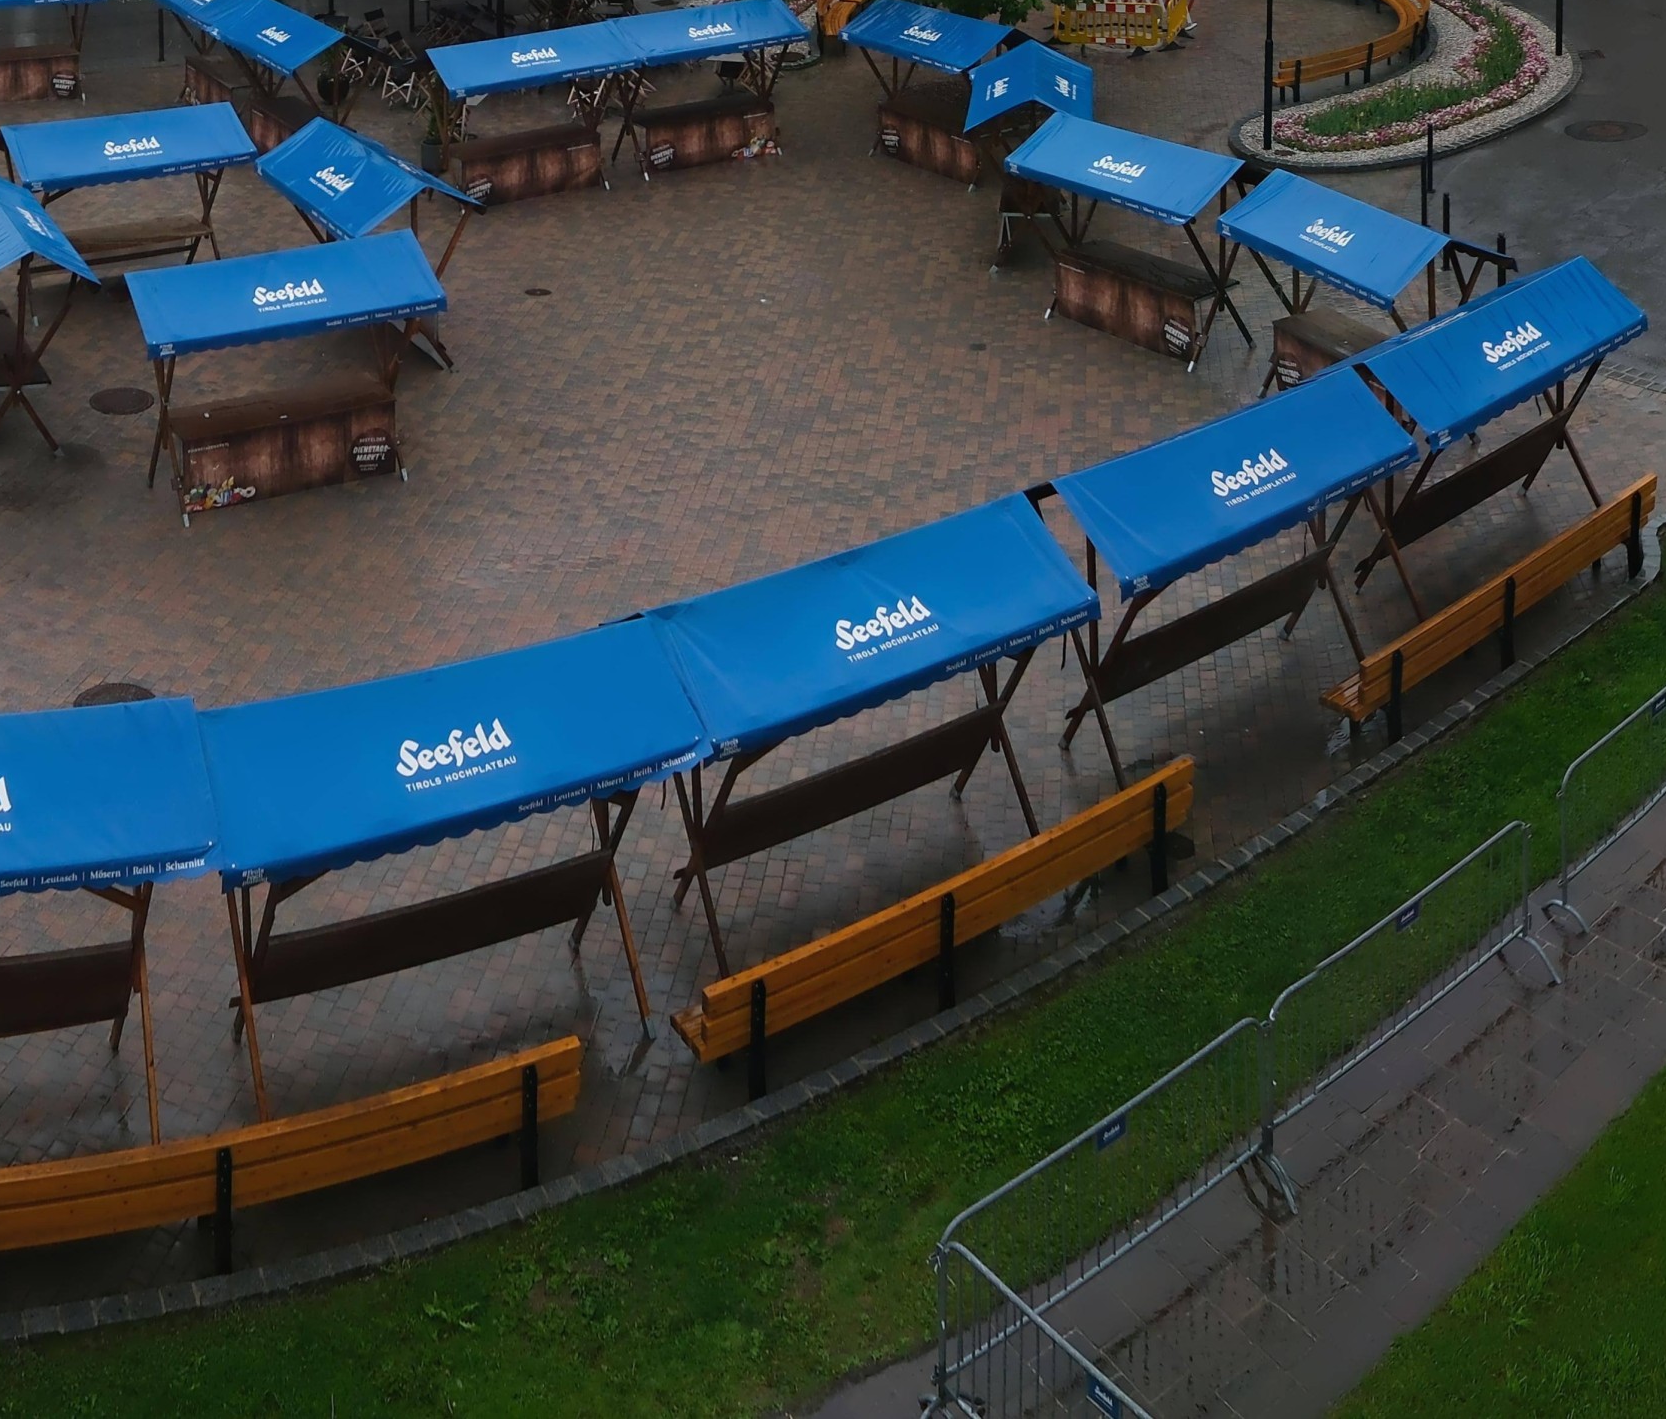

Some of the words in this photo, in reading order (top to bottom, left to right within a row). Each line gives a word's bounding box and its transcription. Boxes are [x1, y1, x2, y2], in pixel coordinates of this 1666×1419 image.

[688, 22, 733, 39] Seefeld
[903, 25, 943, 42] Seefeld
[511, 47, 558, 65] Seefeld
[103, 136, 160, 156] Seefeld
[316, 166, 355, 192] Seefeld
[1092, 155, 1147, 178] Seefeld
[1305, 218, 1356, 247] Seefeld
[252, 278, 325, 306] Seefeld
[258, 304, 281, 313] TIROLS
[282, 297, 327, 309] HOCHPLATEAU
[1482, 320, 1543, 364] Seefeld
[1211, 447, 1289, 497] Seefeld
[1225, 493, 1250, 508] TIROLS
[1250, 471, 1297, 497] HOCHPLATEAU
[835, 595, 931, 650] Seefeld
[847, 646, 878, 664] TIROLS
[880, 622, 940, 651] HOCHPLATEAU
[395, 717, 512, 777] Seefeld
[405, 776, 442, 793] TIROLS
[444, 754, 517, 784] HOCHPLATEAU
[517, 799, 543, 814] Seefeld
[553, 786, 587, 803] Leutasch
[596, 775, 624, 790] Mösern
[633, 765, 653, 779] Reith
[660, 751, 696, 771] Scharnitz
[0, 877, 29, 889] Seefeld
[40, 873, 78, 885] Leutasch
[90, 867, 122, 881] Mösern
[132, 863, 155, 875] Reith
[165, 856, 206, 871] Scharnitz
